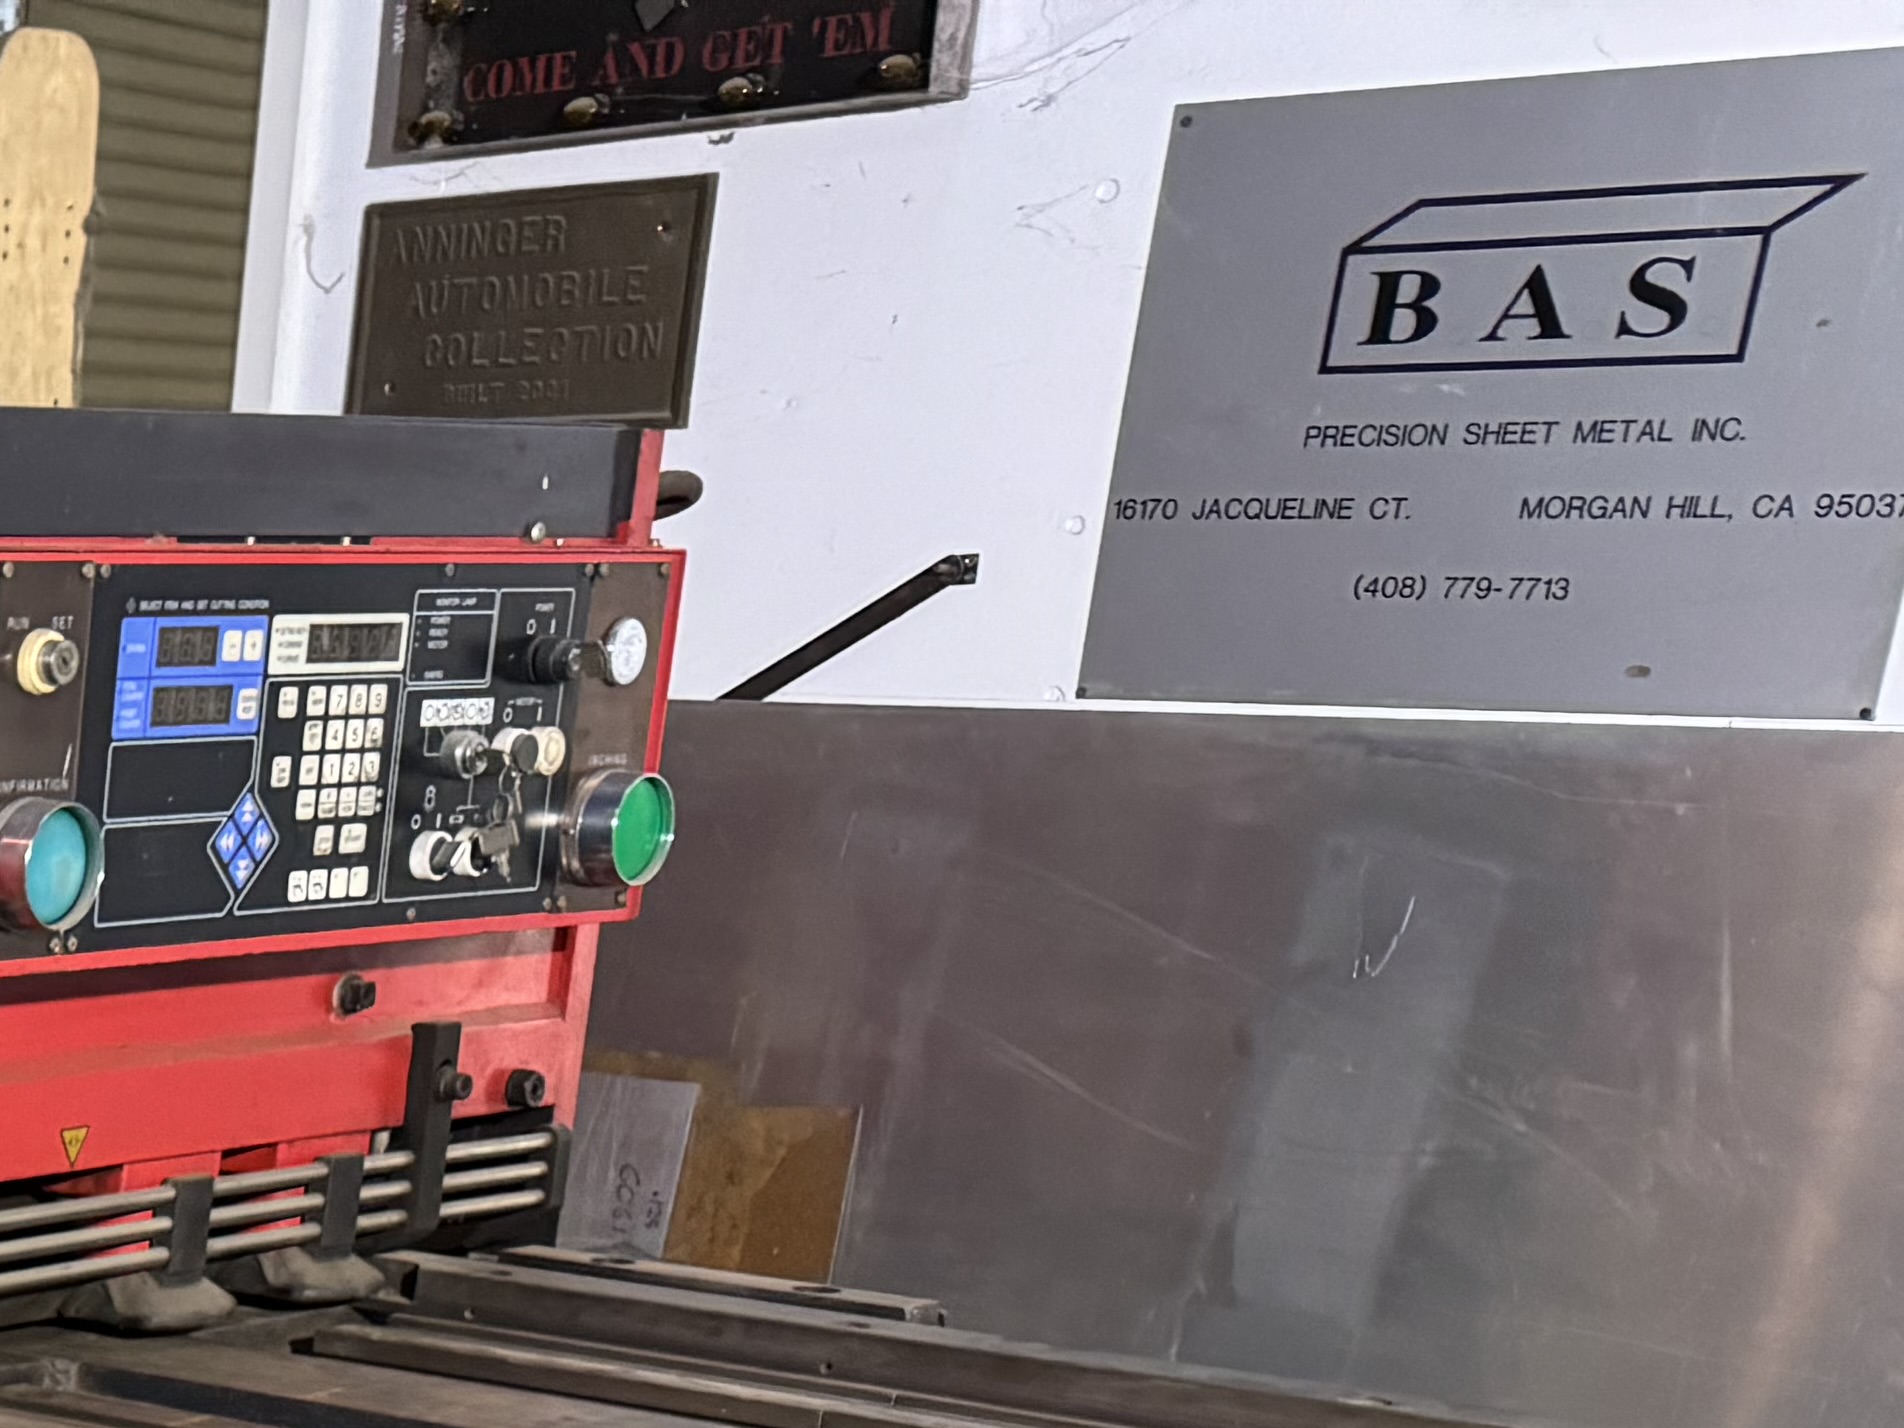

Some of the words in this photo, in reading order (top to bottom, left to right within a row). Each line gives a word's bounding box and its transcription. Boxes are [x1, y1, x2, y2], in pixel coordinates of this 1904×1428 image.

[464, 50, 577, 102] COME
[592, 36, 685, 88] AND
[702, 20, 791, 72] GET
[811, 7, 892, 58] 'EM
[412, 264, 649, 318] AUTOMOBILE
[424, 322, 664, 368] COLLECTION
[1303, 423, 1449, 449] PRECISION
[1463, 421, 1560, 446] SHEET
[1572, 418, 1674, 444] METAL
[1691, 417, 1746, 442] INC.
[1113, 498, 1178, 521] 16170
[1191, 497, 1356, 521] JACQUELINE
[1369, 496, 1412, 520] CT.
[1518, 495, 1652, 520] MORGAN
[1665, 494, 1734, 523] HILL,
[1752, 493, 1795, 519] CA
[1353, 574, 1428, 601] (408)
[1443, 576, 1571, 601] 779-7713
[51, 615, 74, 630] SET
